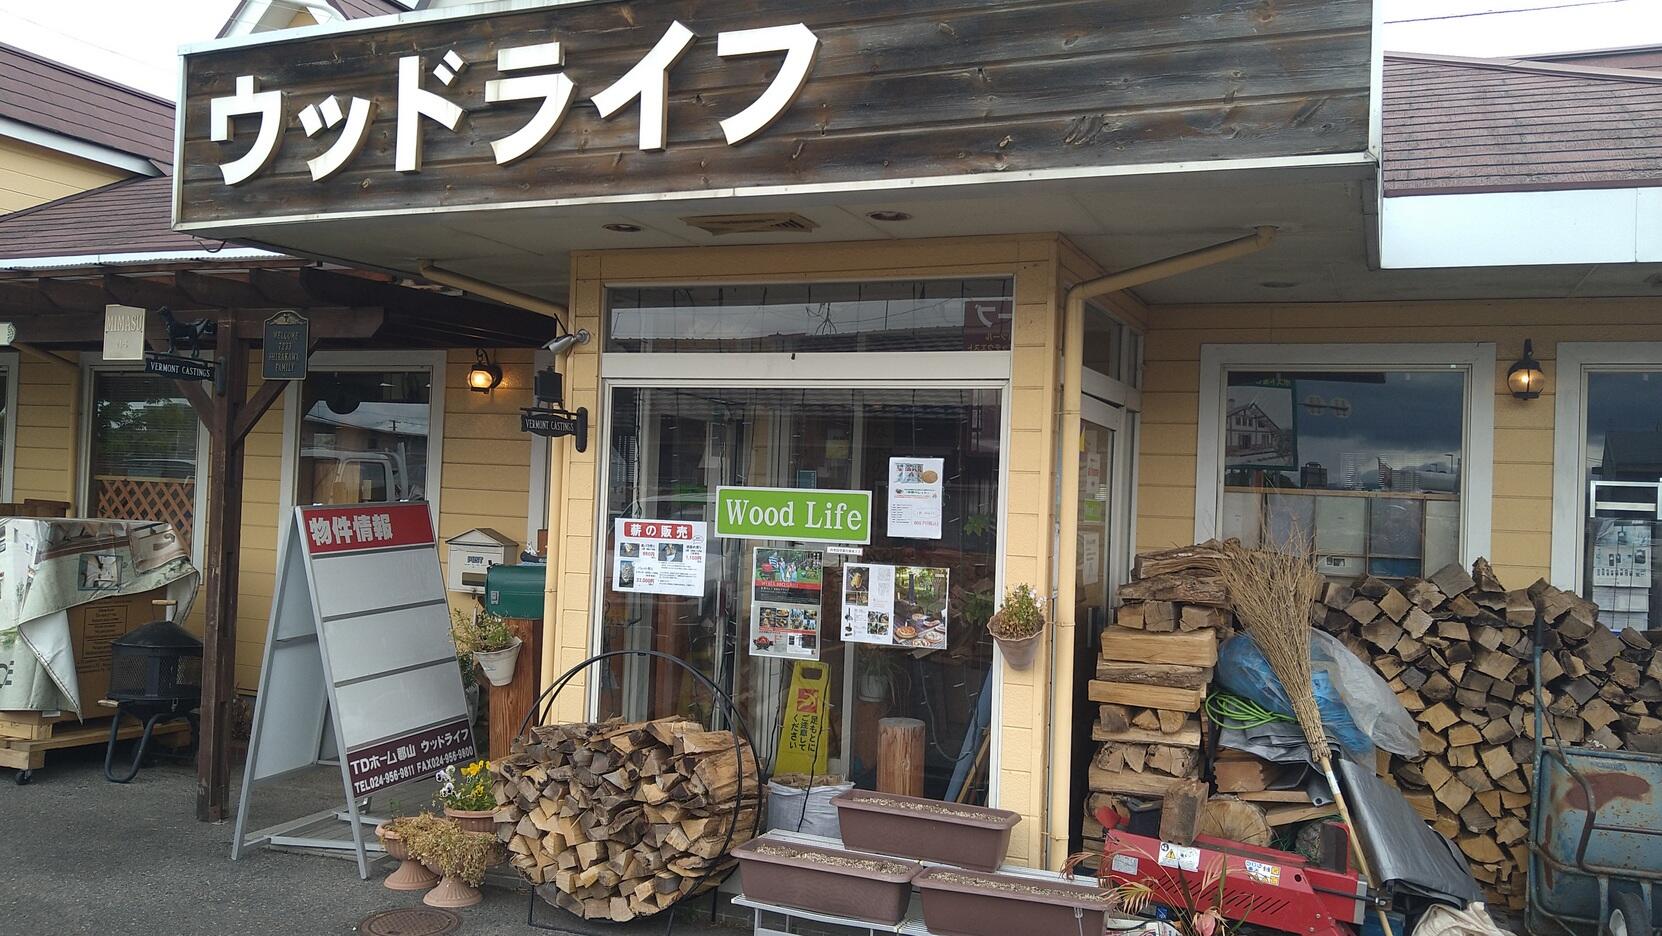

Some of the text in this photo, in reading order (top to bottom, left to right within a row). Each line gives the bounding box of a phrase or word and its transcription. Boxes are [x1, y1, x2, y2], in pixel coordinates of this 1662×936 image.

[210, 20, 820, 186] ウッドライフ
[106, 314, 144, 331] MIMASU
[150, 361, 211, 378] VERMONT CASTINGS
[275, 362, 297, 372] FAMILY
[525, 419, 574, 431] VERMONT CASTINGS
[726, 498, 795, 527] Wood
[805, 501, 862, 530] Life
[309, 513, 393, 546] 物件情報
[630, 523, 688, 539] 薪の販売
[789, 714, 799, 748] ください
[808, 715, 818, 751] 足もとに
[350, 729, 469, 775] TDホーム郡山 ウッドライフ
[353, 764, 416, 793] TEL024-956-9811
